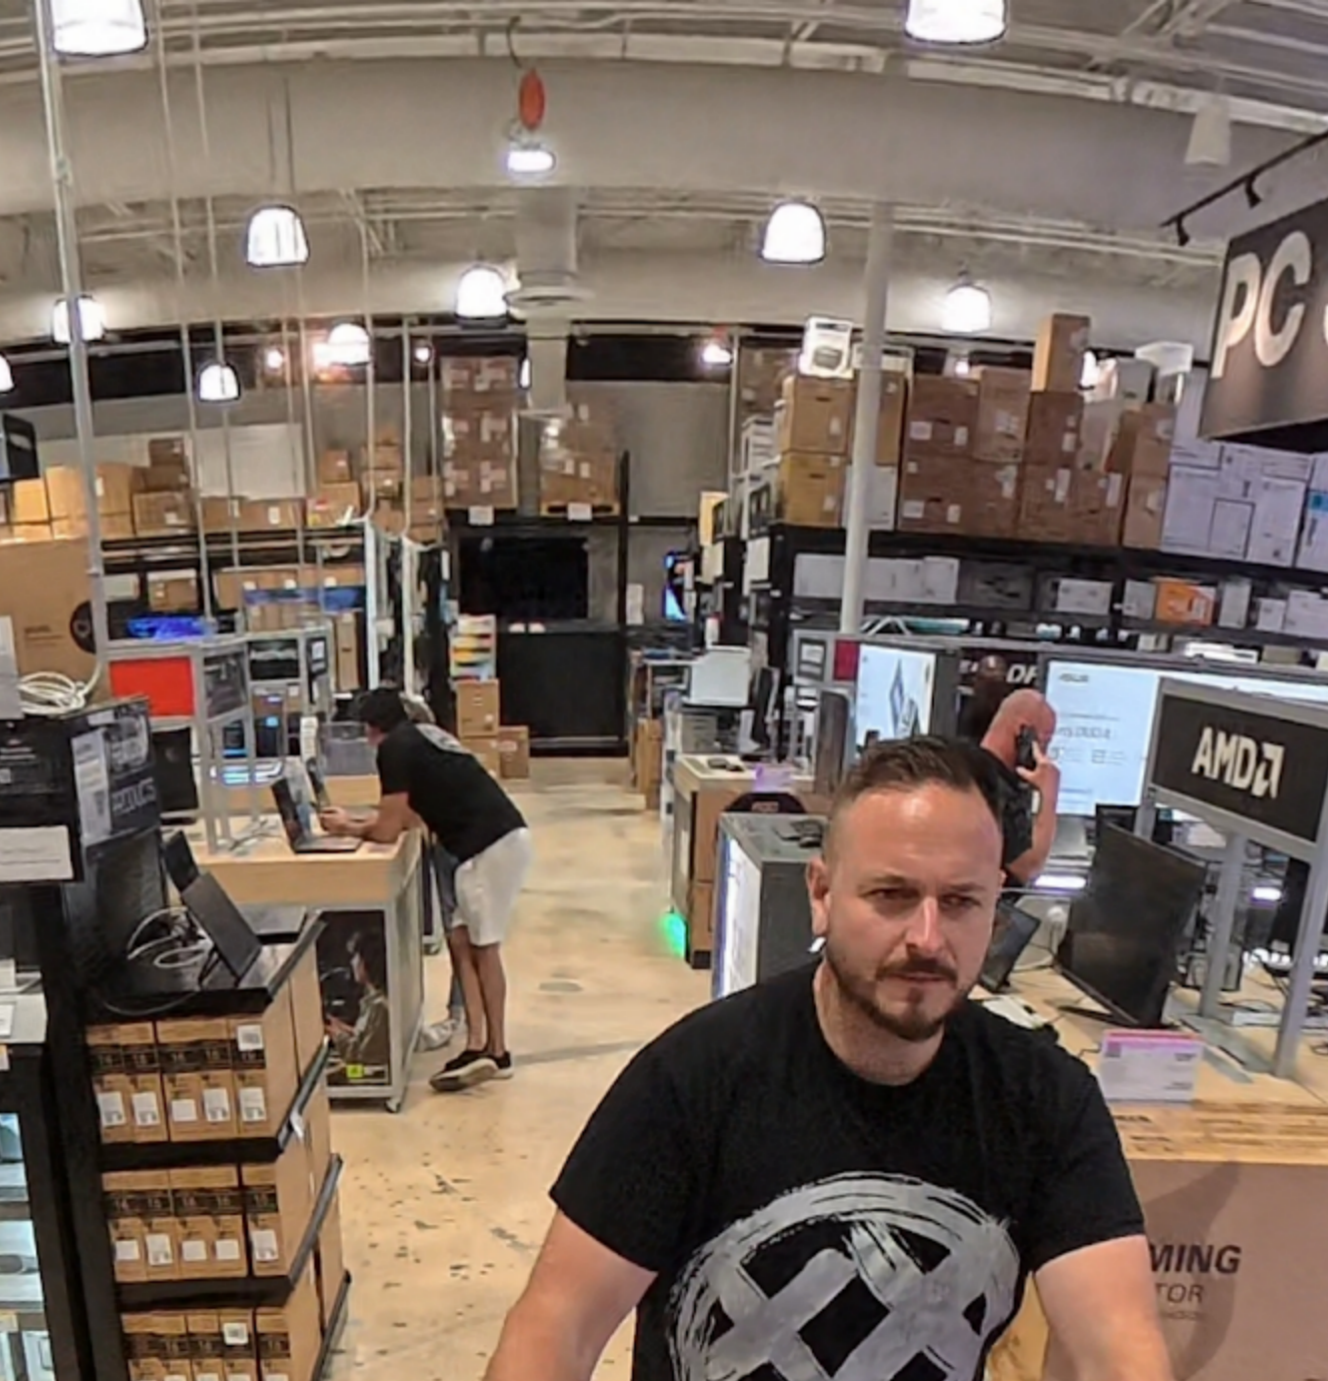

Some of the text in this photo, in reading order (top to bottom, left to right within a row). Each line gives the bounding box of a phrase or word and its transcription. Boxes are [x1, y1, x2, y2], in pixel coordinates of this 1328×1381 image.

[1210, 230, 1314, 380] PC
[1191, 727, 1258, 790] AMD
[1149, 1243, 1242, 1275] MING
[1155, 1283, 1205, 1304] TOR
